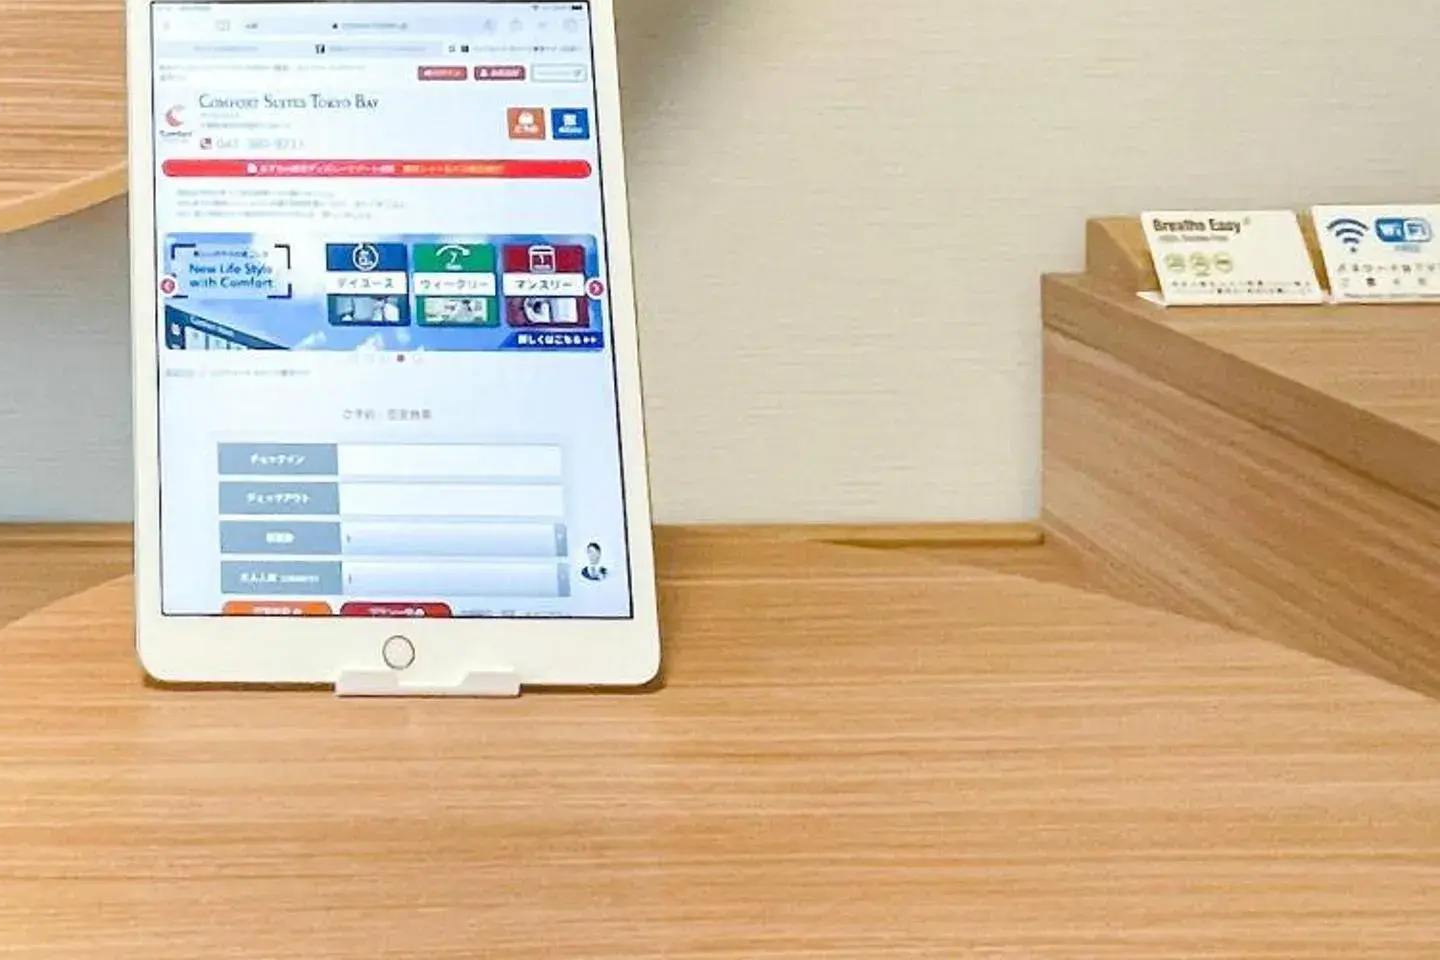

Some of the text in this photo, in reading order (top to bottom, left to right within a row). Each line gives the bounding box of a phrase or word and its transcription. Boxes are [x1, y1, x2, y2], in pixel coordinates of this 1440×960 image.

[1153, 218, 1241, 233] Breathe Easy
[220, 276, 273, 289] Comfort
[515, 279, 572, 290] マンスリー
